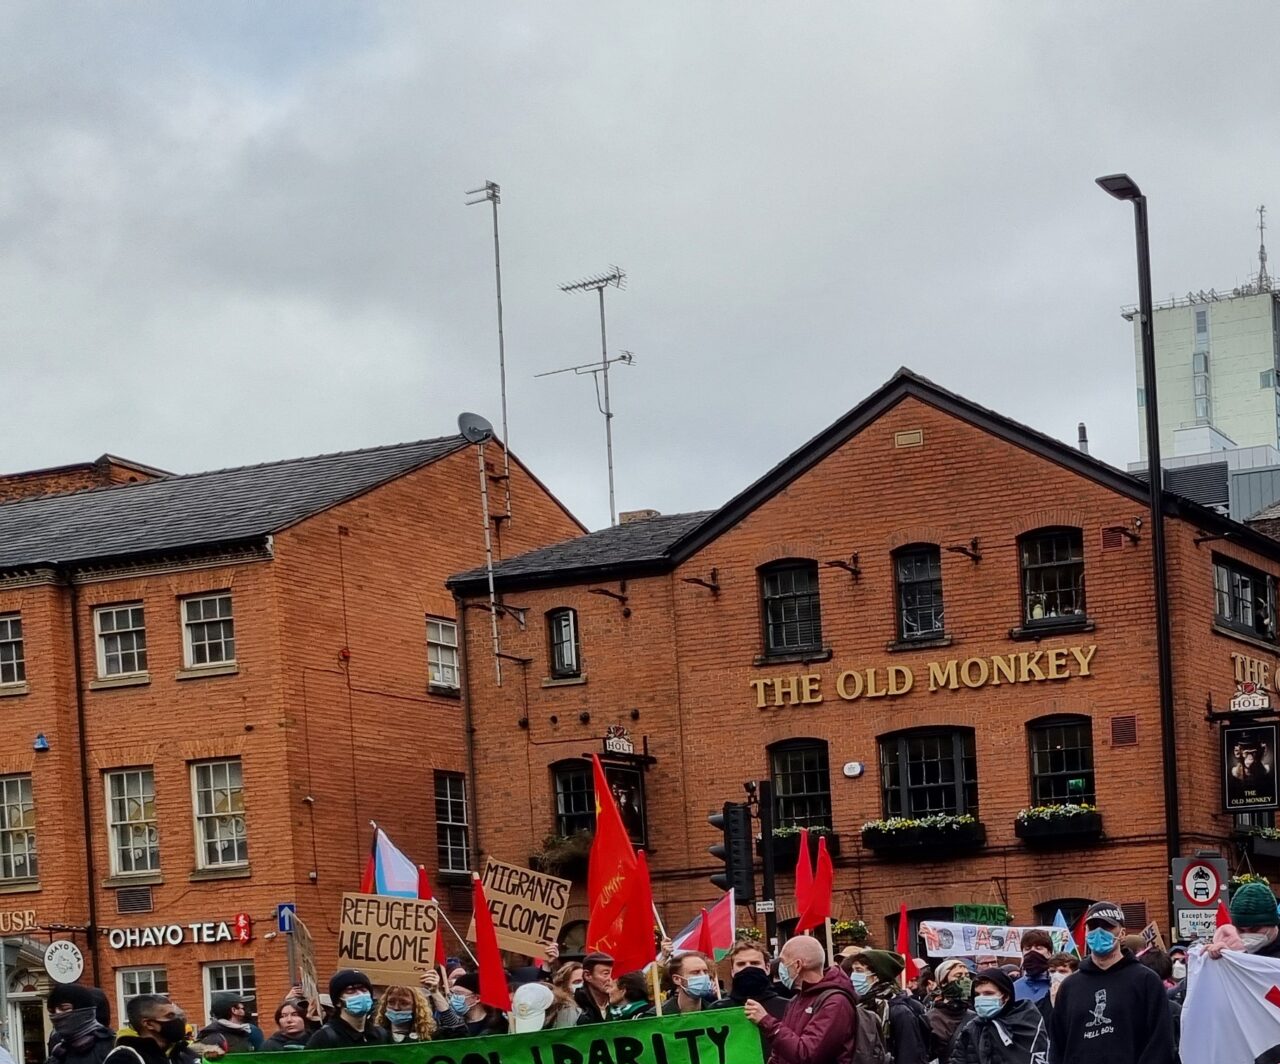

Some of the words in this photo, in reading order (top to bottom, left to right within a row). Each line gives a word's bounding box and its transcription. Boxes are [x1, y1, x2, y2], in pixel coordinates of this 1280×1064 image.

[750, 673, 823, 708] THE
[836, 666, 913, 701] OLD
[928, 645, 1098, 693] MONKEY
[1231, 652, 1270, 690] THE
[1232, 699, 1266, 709] HOLT
[608, 741, 631, 752] HOLT
[482, 862, 567, 910] MIGRANTS
[342, 897, 438, 933] REFUGEES
[109, 925, 183, 949] OHAYO
[189, 922, 232, 943] TEA
[338, 930, 430, 965] WELCOME
[47, 944, 69, 961] OHAYO
[71, 948, 81, 963] TEA
[1084, 1030, 1099, 1039] HELL
[1101, 1026, 1114, 1036] BOY
